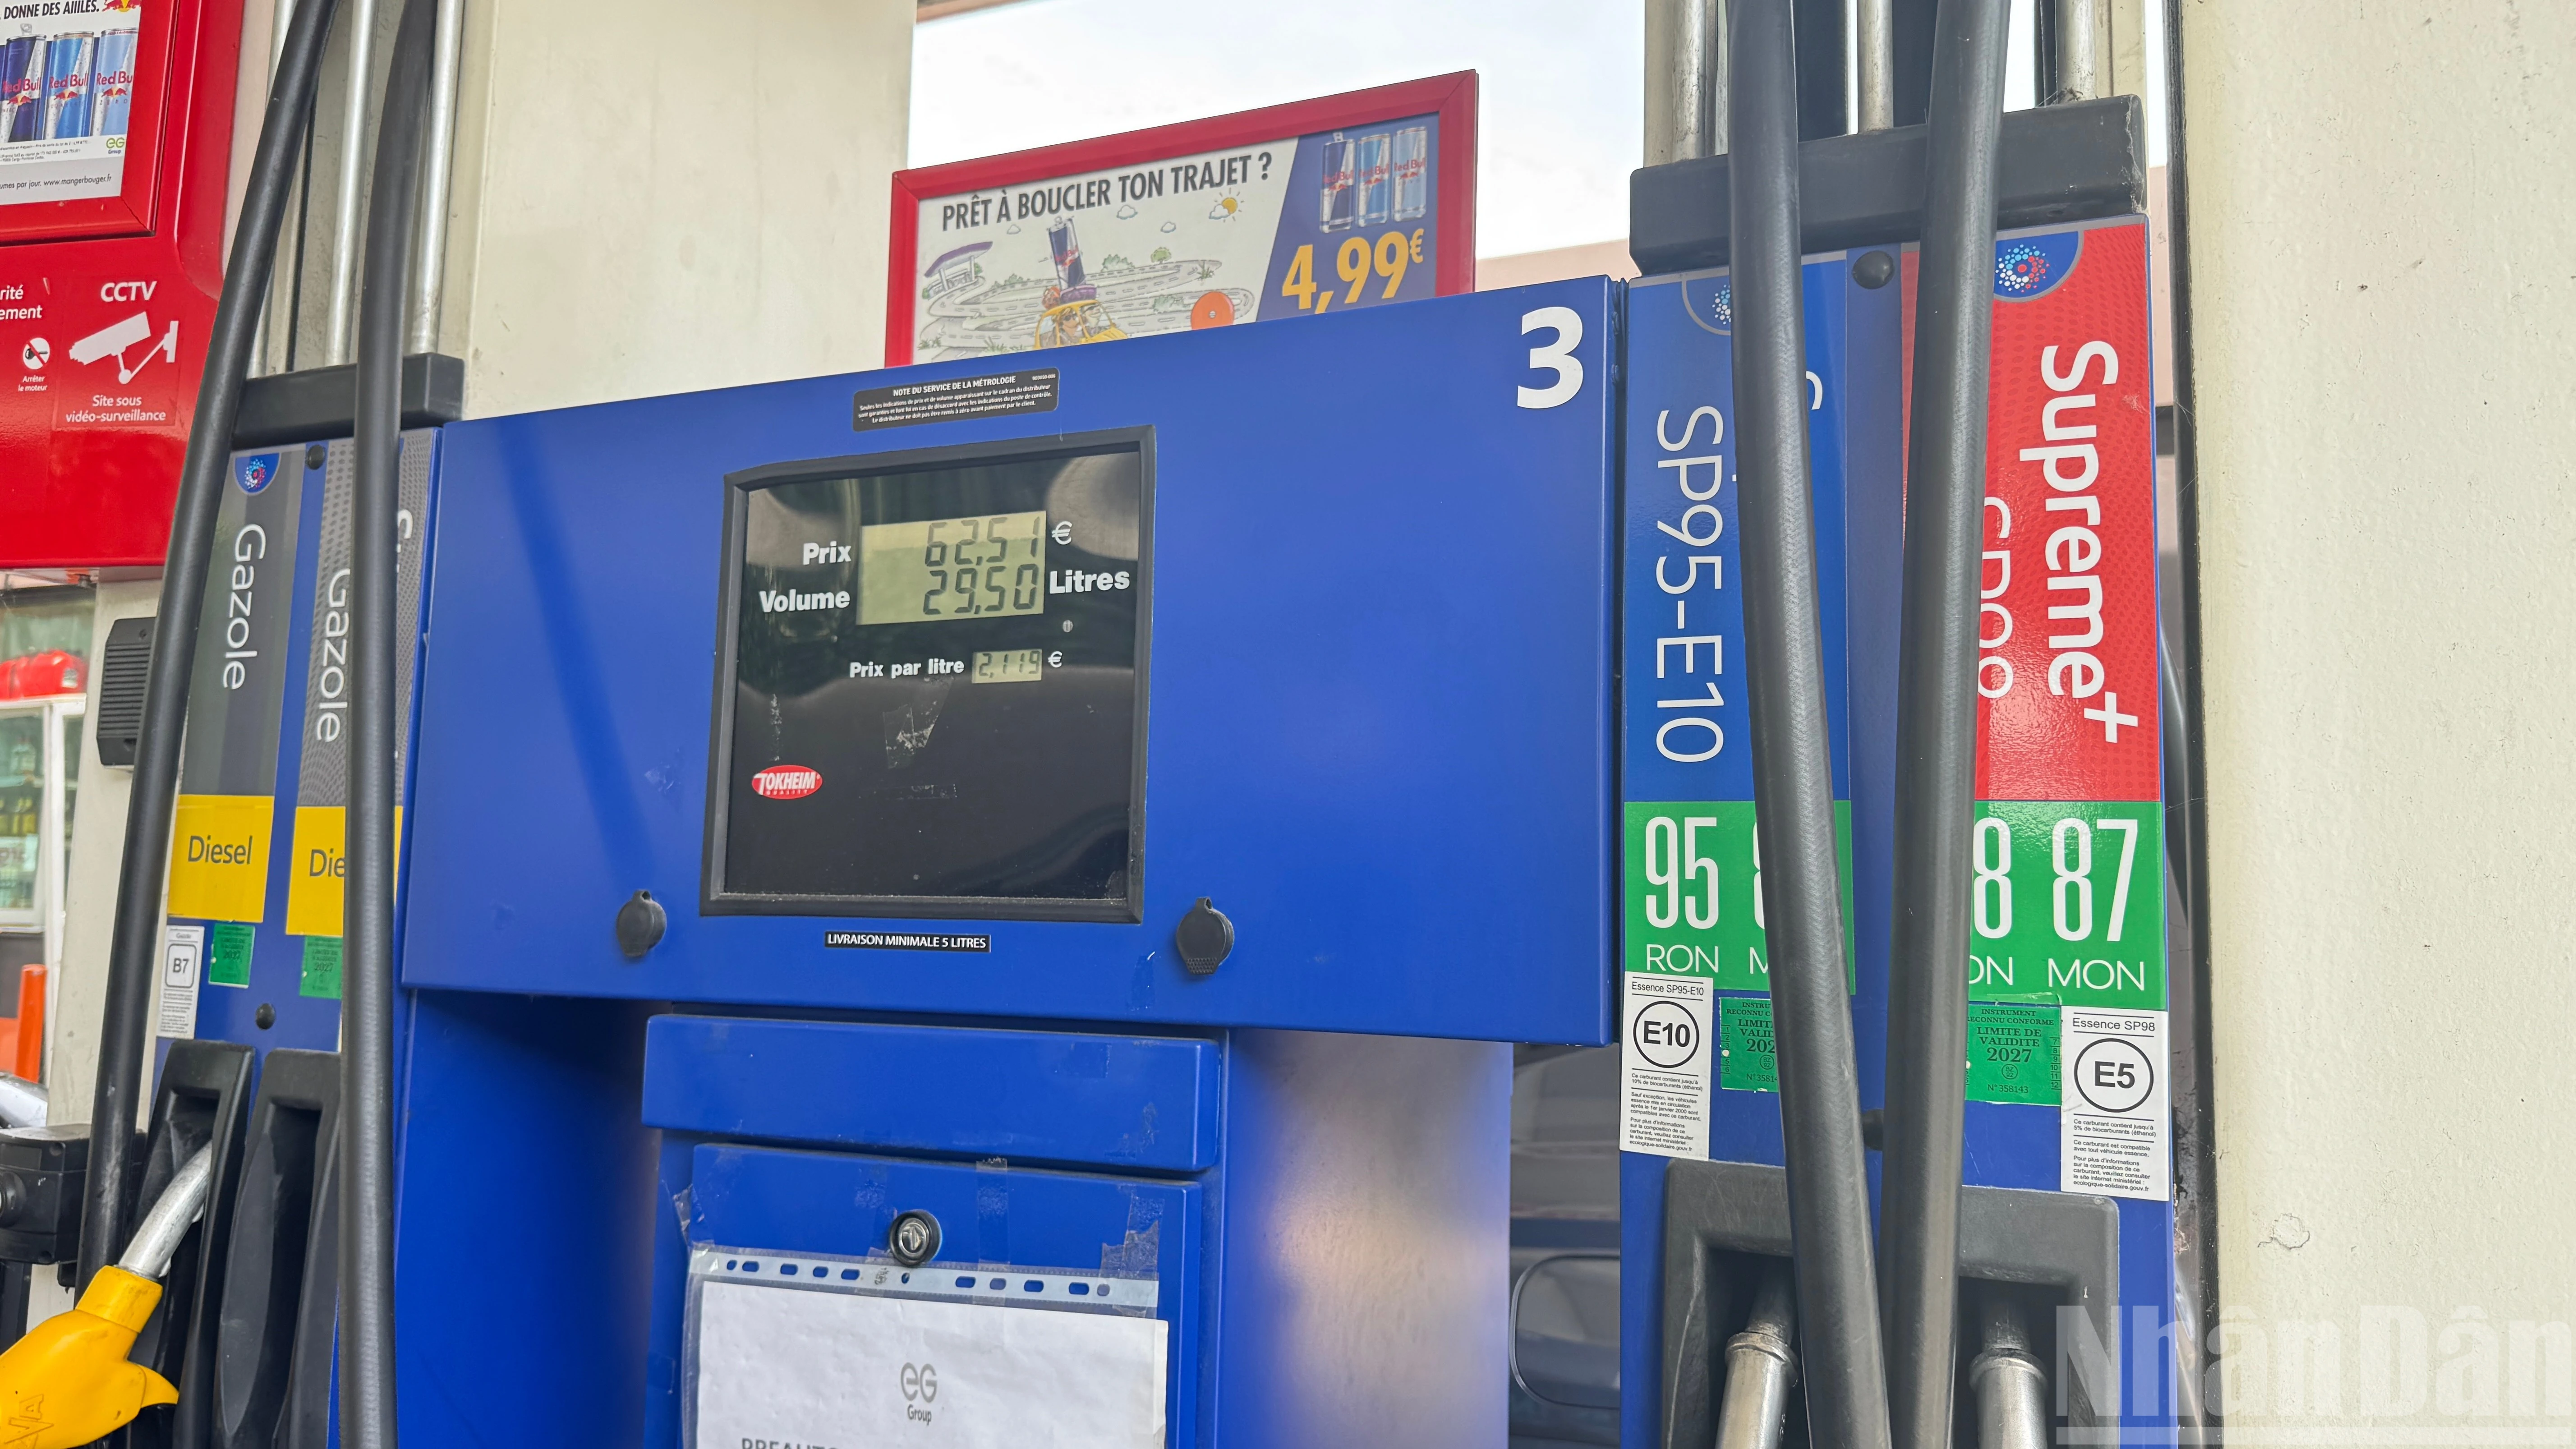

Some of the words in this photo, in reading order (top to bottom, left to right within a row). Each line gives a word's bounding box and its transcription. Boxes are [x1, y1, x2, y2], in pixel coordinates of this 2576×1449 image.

[4, 4, 40, 19] DONNE
[42, 2, 60, 16] DES
[23, 77, 41, 91] Bull
[49, 74, 67, 88] Red
[96, 71, 116, 85] Red
[118, 71, 132, 83] Bu
[17, 181, 27, 190] par
[44, 173, 111, 186] www.mangerbouger.fr
[943, 195, 992, 231] PRÊT
[997, 189, 1011, 223] À
[1018, 179, 1111, 219] BOUCLER
[1118, 170, 1164, 202] TON
[1171, 155, 1251, 194] TRAJET
[1258, 152, 1272, 180] ?
[101, 281, 157, 302] CCTV
[1517, 307, 1583, 409] 3
[893, 388, 911, 396] NOTE
[924, 384, 951, 393] SERVICE
[973, 376, 1016, 387] MÉTROLOGIE
[954, 392, 984, 400] apparaissant
[92, 395, 114, 407] Site
[117, 396, 142, 406] sous
[66, 409, 166, 423] vidéo-surveillance
[925, 516, 1040, 567] 62,51
[1052, 521, 1072, 545] €
[2019, 340, 2139, 743] Supreme+
[803, 542, 852, 566] Prix
[923, 563, 1039, 616] 29,50
[1049, 570, 1130, 594] Litres
[1656, 406, 1724, 763] SP95-E10
[223, 524, 266, 690] Gazole
[759, 589, 851, 614] Volume
[317, 568, 350, 742] Gazole
[979, 651, 1041, 678] 2,119
[1048, 651, 1063, 668] €
[850, 662, 883, 678] Prix
[891, 663, 921, 679] par
[928, 658, 964, 674] litre
[754, 772, 816, 795] TOKHEIM
[188, 835, 253, 865] Diesel
[309, 848, 345, 877] Die
[1646, 816, 1719, 929] 95
[1973, 818, 2012, 938] 8
[2052, 818, 2138, 941] 87
[828, 934, 883, 945] LIVRAISON
[885, 935, 939, 947] MINIMALE
[942, 938, 948, 947] 5
[951, 938, 986, 948] LITRES
[173, 958, 189, 974] B7
[1647, 944, 1718, 973] RON
[2048, 958, 2144, 991] MON
[1632, 982, 1664, 992] Essence
[1666, 985, 1704, 996] SP95-E10
[1644, 1021, 1690, 1047] E10
[1738, 1019, 1773, 1028] LIMIT
[1739, 1029, 1774, 1038] VALID
[1977, 1027, 2020, 1036] LIMITE
[2024, 1029, 2041, 1037] DE
[2073, 1018, 2120, 1029] Essence
[2125, 1021, 2155, 1031] SP98
[1746, 1039, 1775, 1053] 202
[1979, 1037, 2039, 1047] VALIDITE
[1987, 1048, 2032, 1063] 2027
[2095, 1061, 2135, 1089] E5
[2101, 1157, 2139, 1166] d'informations
[907, 1404, 932, 1426] Group
